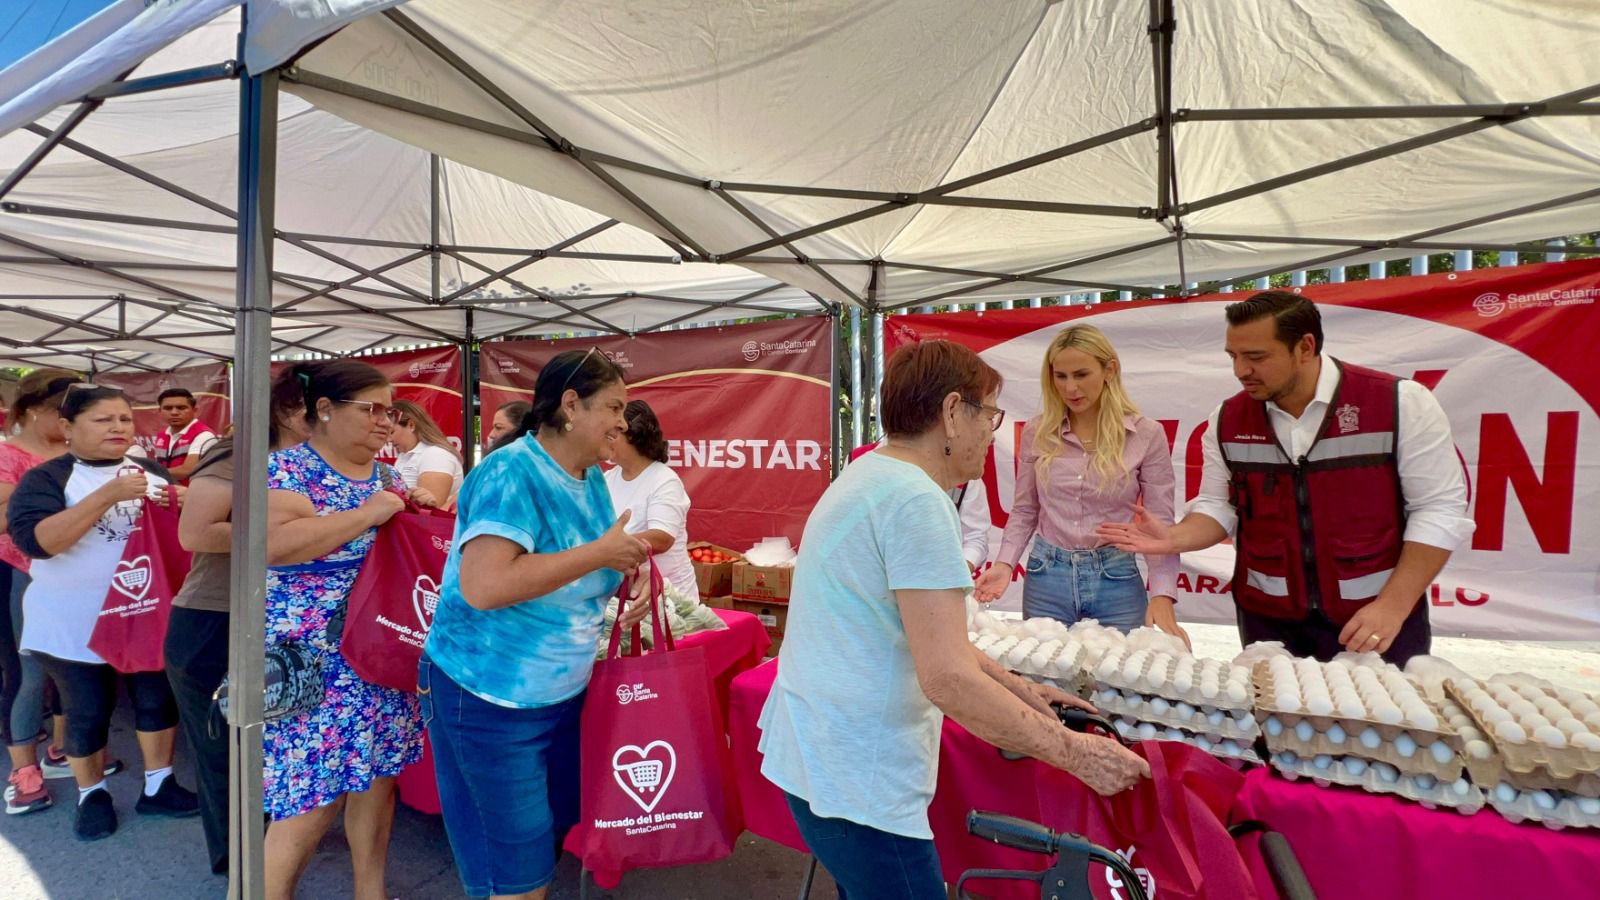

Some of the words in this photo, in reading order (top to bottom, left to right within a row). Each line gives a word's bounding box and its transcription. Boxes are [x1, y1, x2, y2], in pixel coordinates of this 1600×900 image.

[1507, 287, 1600, 304] SantaCatarin
[760, 340, 816, 351] SantaCatarina
[667, 439, 822, 471] ENESTAR
[99, 604, 128, 616] ercado
[375, 614, 412, 635] Mercado
[594, 816, 635, 829] Mercado
[636, 814, 653, 825] del
[654, 810, 704, 823] Bienestar
[625, 822, 677, 836] SantaCatarina
